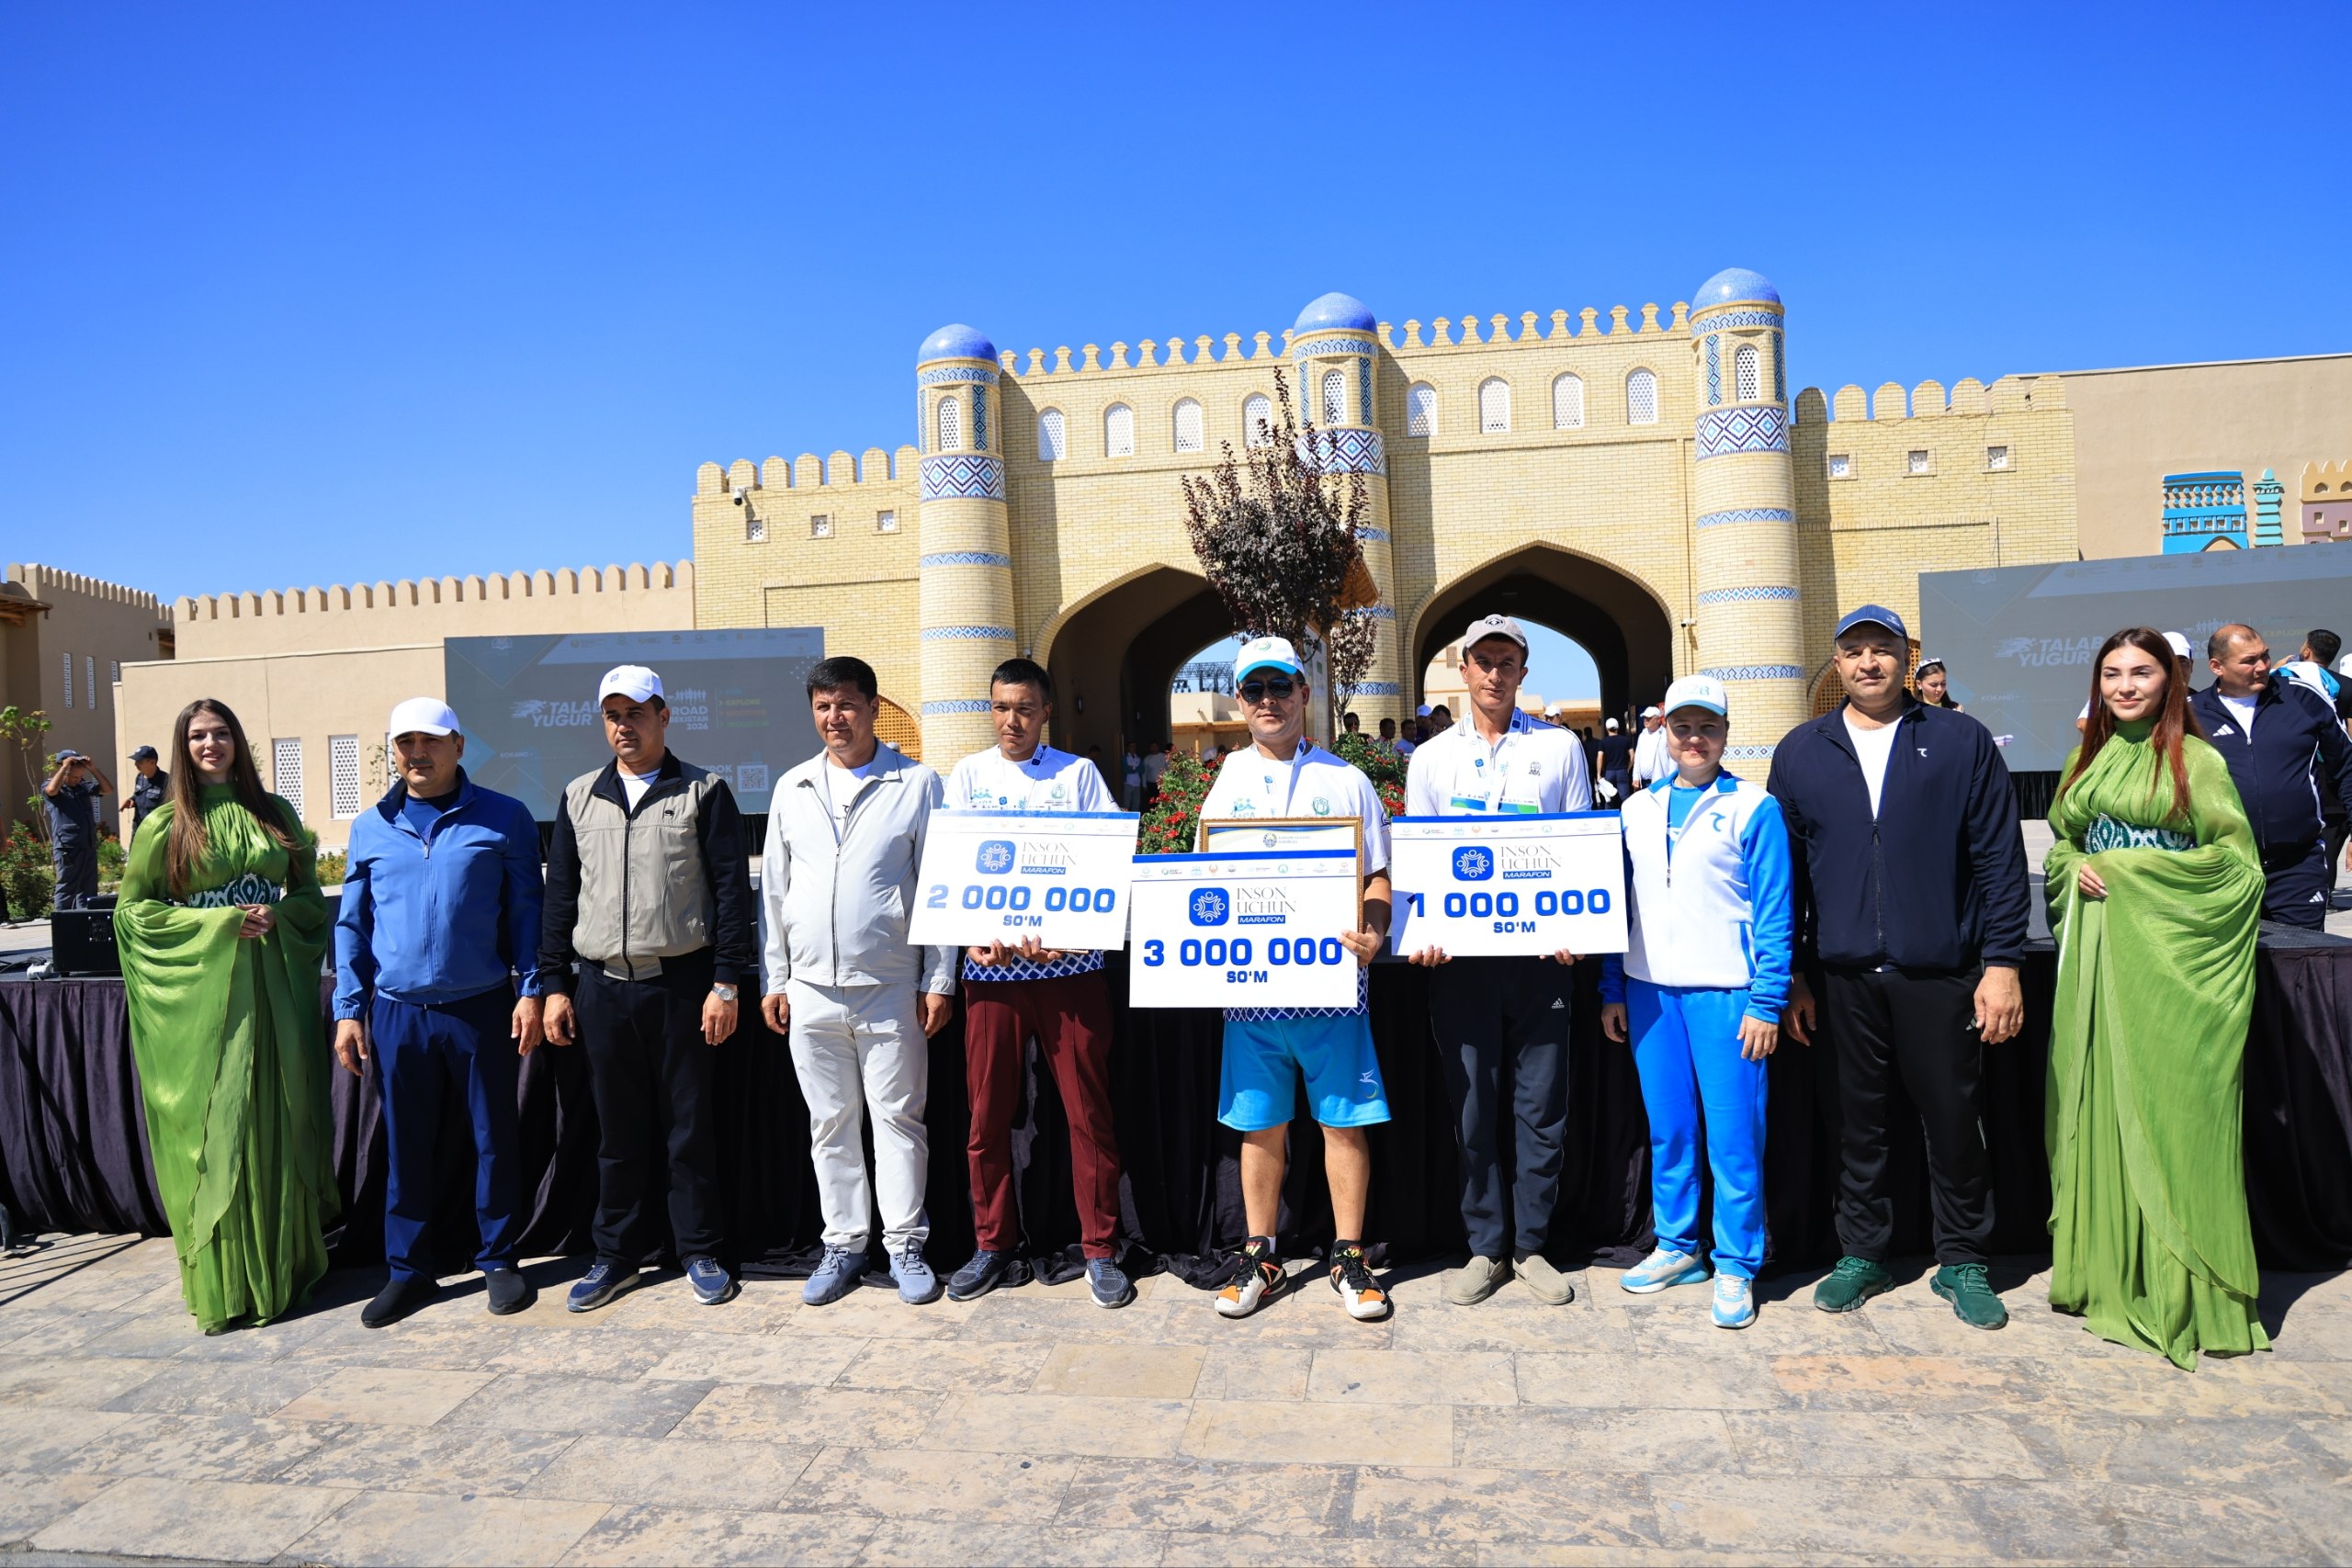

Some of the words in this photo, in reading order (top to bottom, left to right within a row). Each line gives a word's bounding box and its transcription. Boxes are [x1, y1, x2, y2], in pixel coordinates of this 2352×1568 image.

[2018, 651, 2091, 668] YUGUR
[532, 713, 593, 728] YUGUR
[686, 723, 709, 731] 2026
[1022, 841, 1071, 853] INSON
[1500, 845, 1552, 857] INSON
[1021, 853, 1079, 866] UCHUN
[1500, 857, 1562, 870] UCHUN
[926, 884, 949, 908] 2
[961, 885, 1031, 911] 000
[1045, 886, 1115, 913] 000
[1237, 886, 1286, 900] INSON
[1237, 900, 1297, 914] UCHUN
[1407, 892, 1425, 918] 1
[1443, 892, 1519, 918] 000
[1534, 888, 1611, 916] 000
[1002, 915, 1043, 927] SO'M
[1493, 920, 1536, 933] SO'M
[1143, 940, 1165, 966] 3
[1180, 938, 1252, 966] 000
[1268, 937, 1342, 965] 000
[1227, 970, 1268, 983] SO'M
